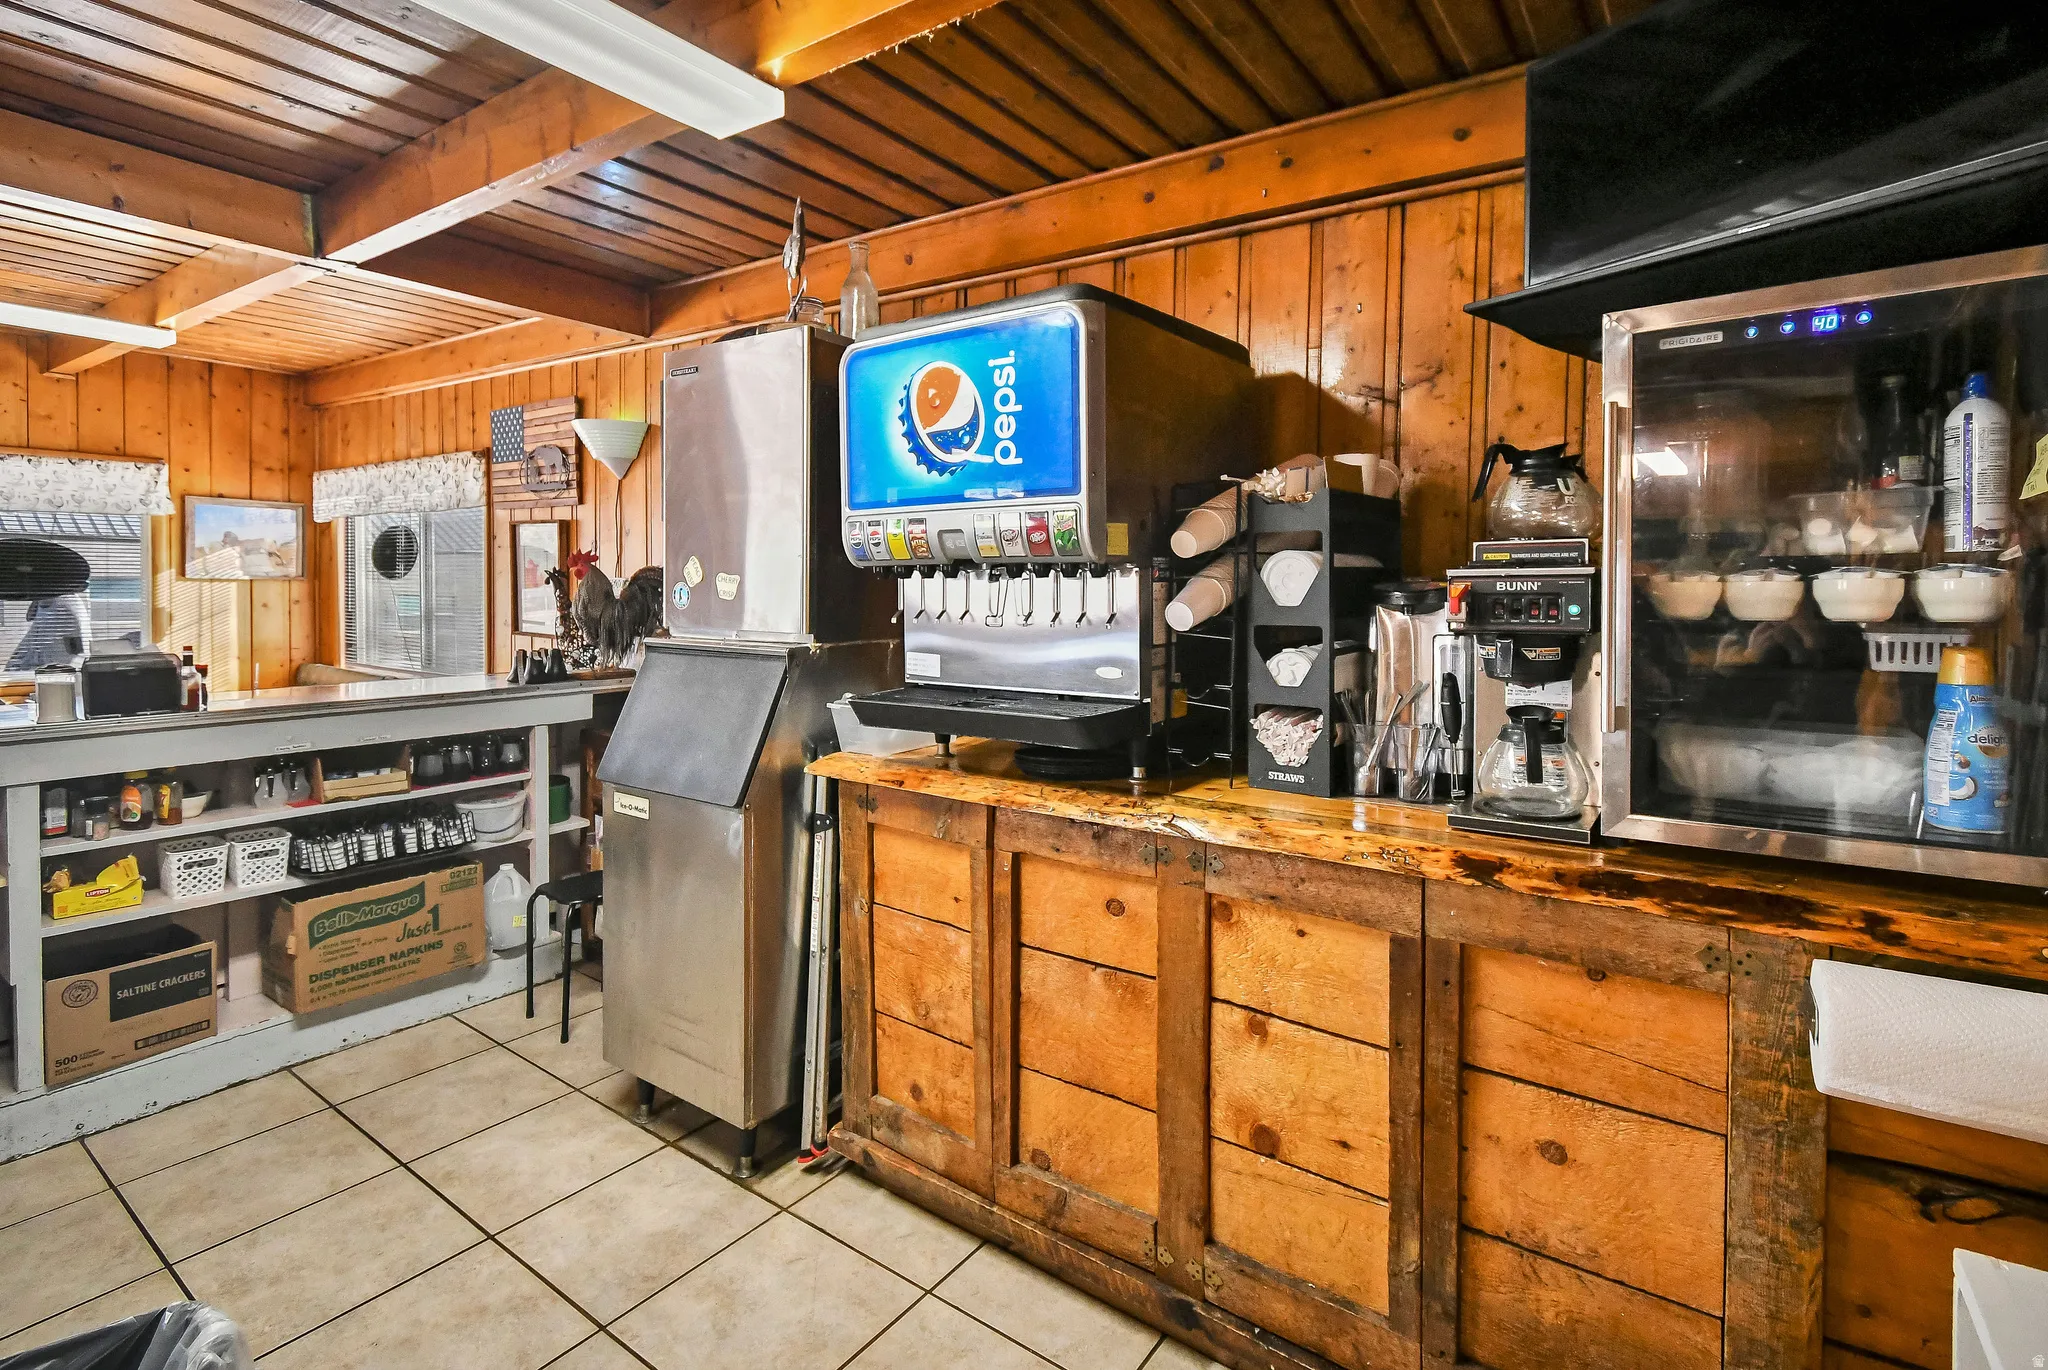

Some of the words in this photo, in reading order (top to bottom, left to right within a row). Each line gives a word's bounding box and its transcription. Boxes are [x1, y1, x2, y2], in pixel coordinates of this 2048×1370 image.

[1814, 316, 1836, 330] 40
[1662, 333, 1719, 347] FRIGIDAIRE
[1496, 581, 1539, 591] BUNN
[1268, 770, 1305, 784] STRAWS
[620, 801, 648, 814] Ice-O-Matic
[86, 887, 111, 897] LIPTON
[395, 920, 432, 943] Just
[427, 903, 441, 932] 1
[308, 955, 386, 985] DISPENSER
[389, 939, 444, 962] NAPKINS
[116, 981, 157, 1000] SALTINE
[158, 968, 207, 990] CRACKERS
[54, 1053, 78, 1069] 500
